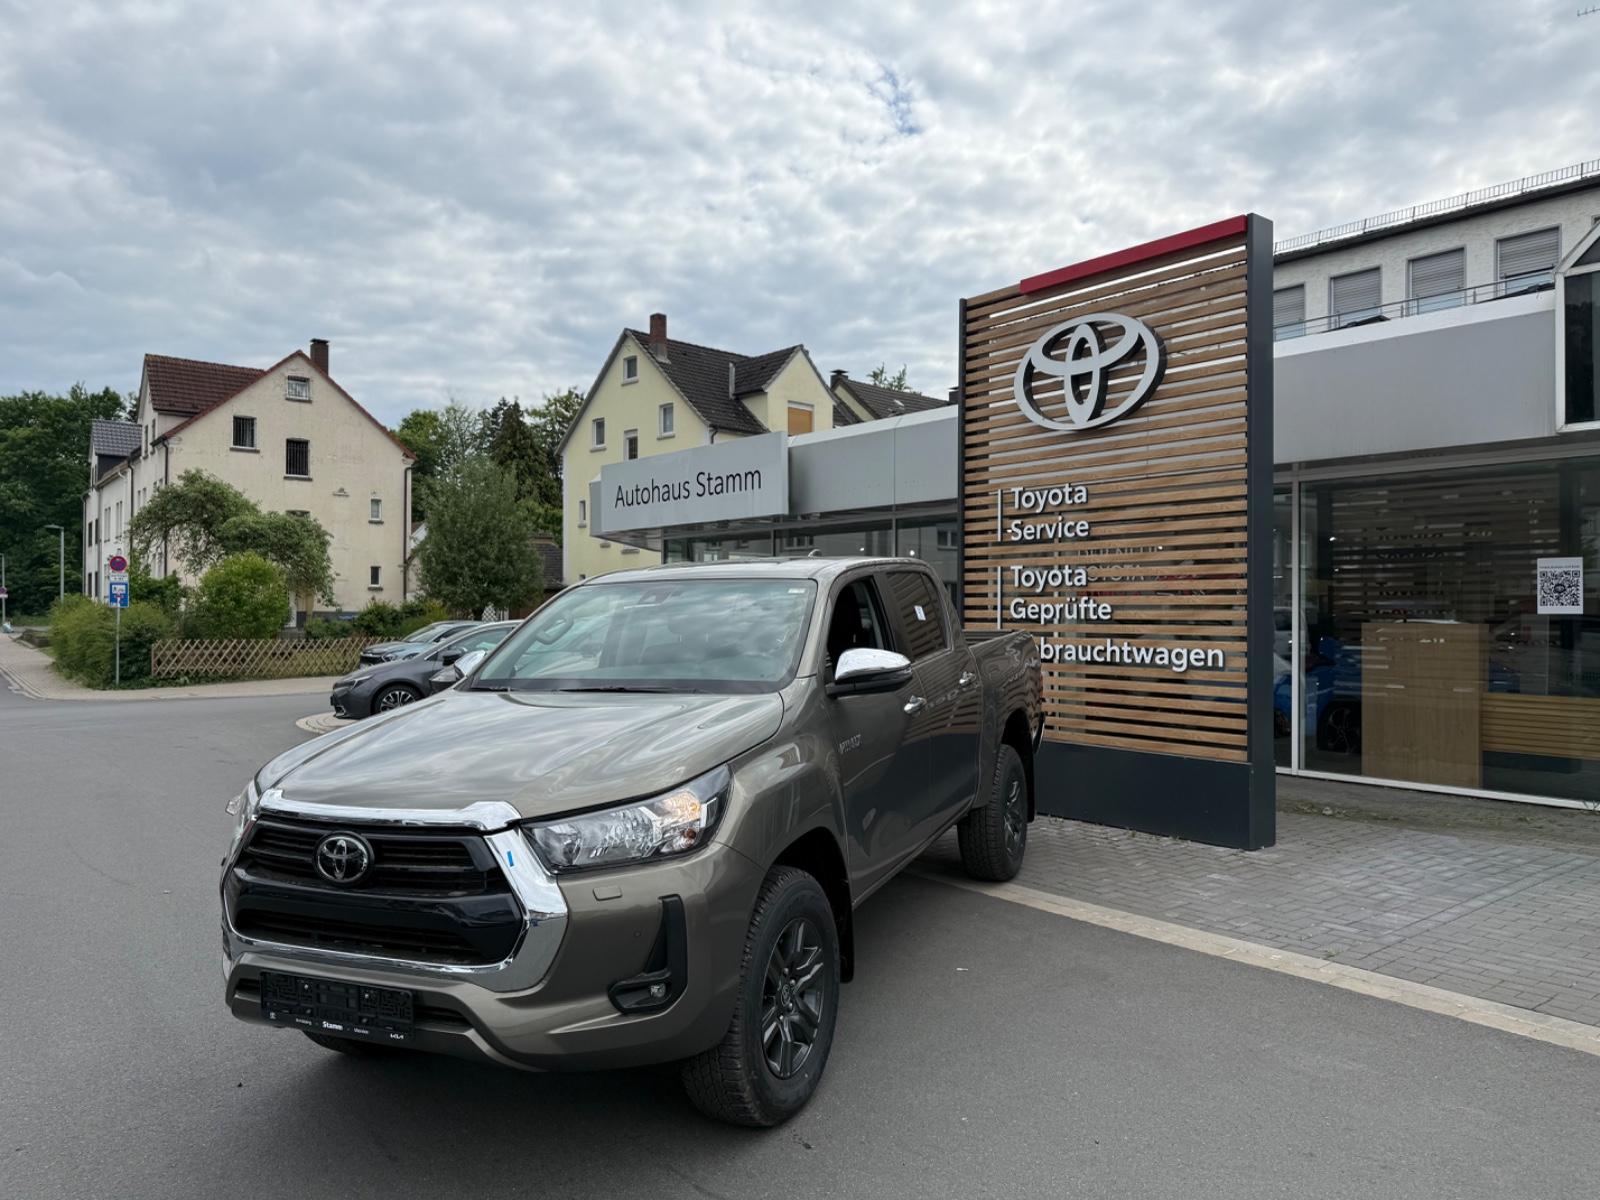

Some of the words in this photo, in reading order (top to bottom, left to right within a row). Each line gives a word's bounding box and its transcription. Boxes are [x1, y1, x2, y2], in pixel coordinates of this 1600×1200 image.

[615, 478, 690, 508] Autohaus
[696, 469, 762, 497] Stamm
[1010, 483, 1088, 512] Toyota
[1010, 516, 1089, 541] Service
[1010, 565, 1088, 592] Toyota
[1010, 596, 1112, 624] Geprüfte
[1037, 637, 1224, 672] brauchtwagen
[322, 1021, 343, 1031] Stamm
